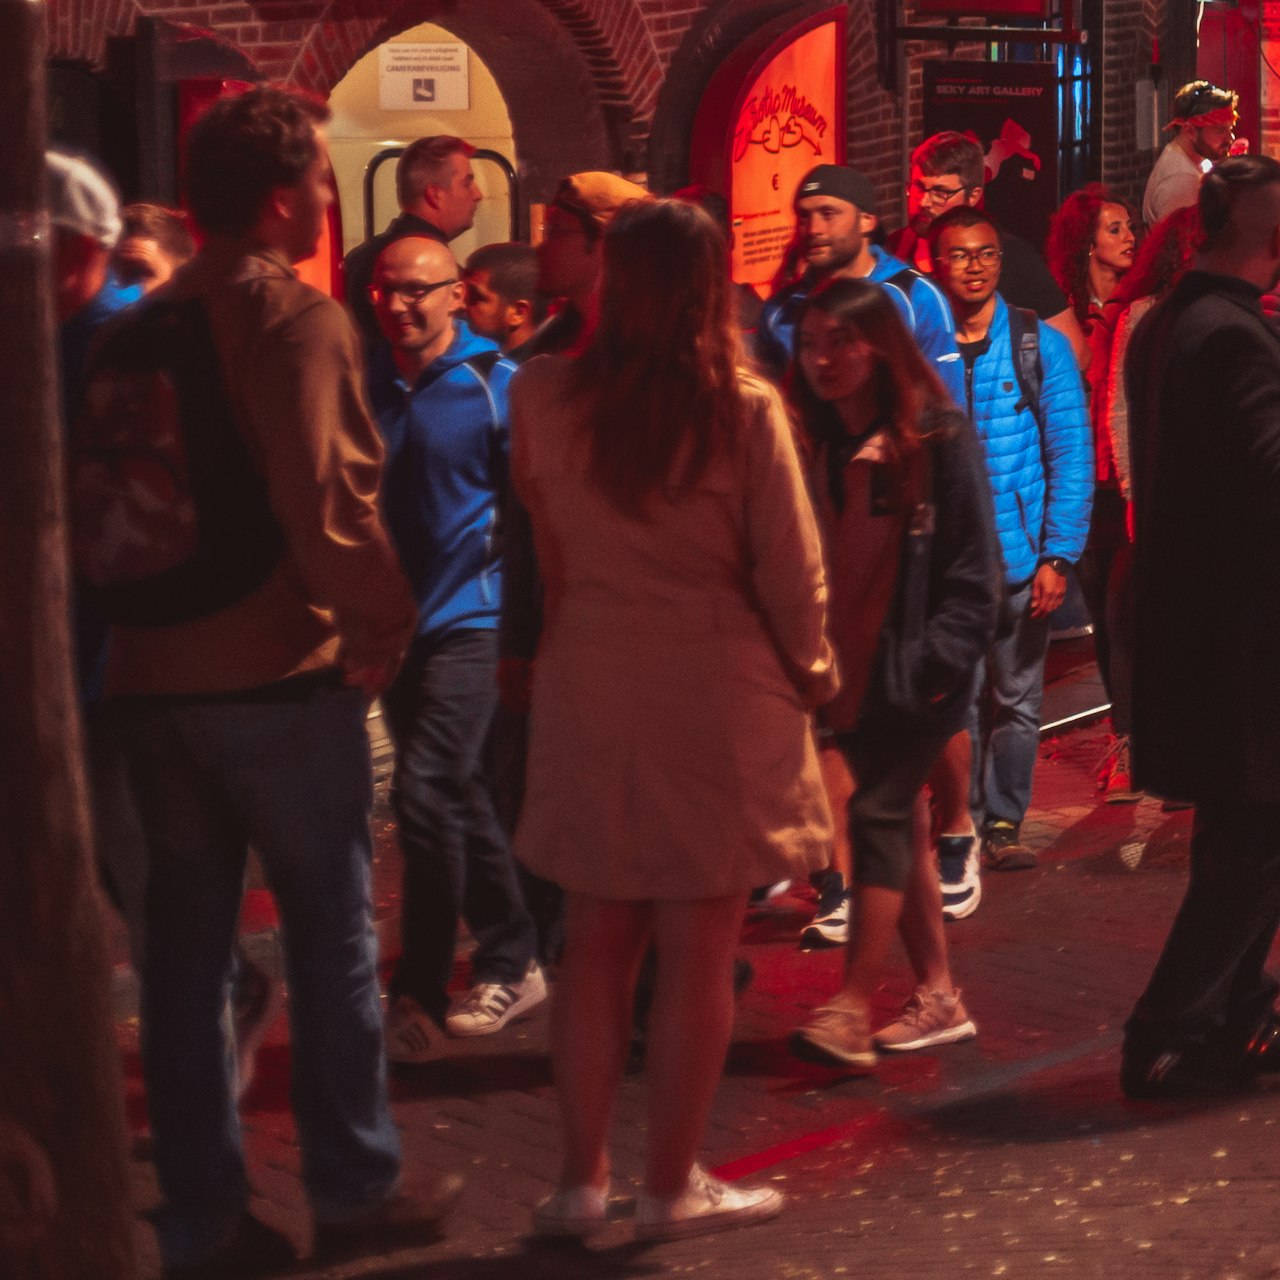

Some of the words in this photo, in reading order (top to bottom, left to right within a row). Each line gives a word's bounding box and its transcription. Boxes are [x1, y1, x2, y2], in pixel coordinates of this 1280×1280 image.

[936, 84, 966, 95] SEXY
[968, 85, 991, 95] ART
[993, 86, 1044, 97] GALLERY
